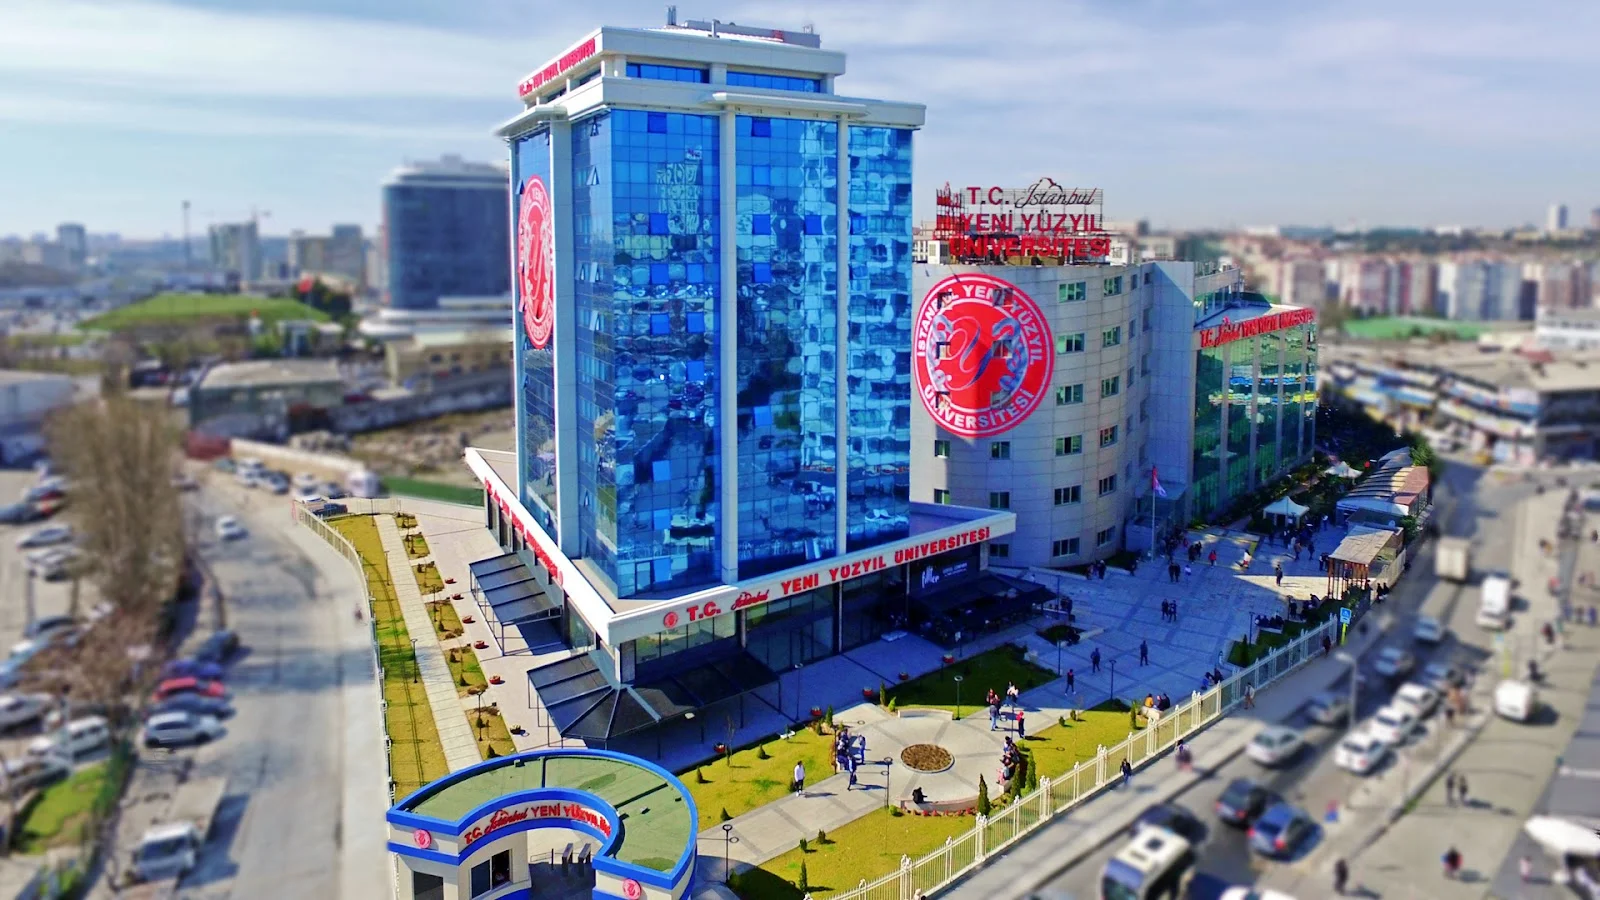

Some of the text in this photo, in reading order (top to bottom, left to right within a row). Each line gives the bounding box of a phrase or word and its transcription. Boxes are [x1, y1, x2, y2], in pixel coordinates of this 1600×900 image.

[966, 186, 1010, 205] T.C.
[1020, 209, 1103, 232] YÜZYIL
[1009, 300, 1042, 366] YÜZYIL
[686, 601, 721, 622] T.C.
